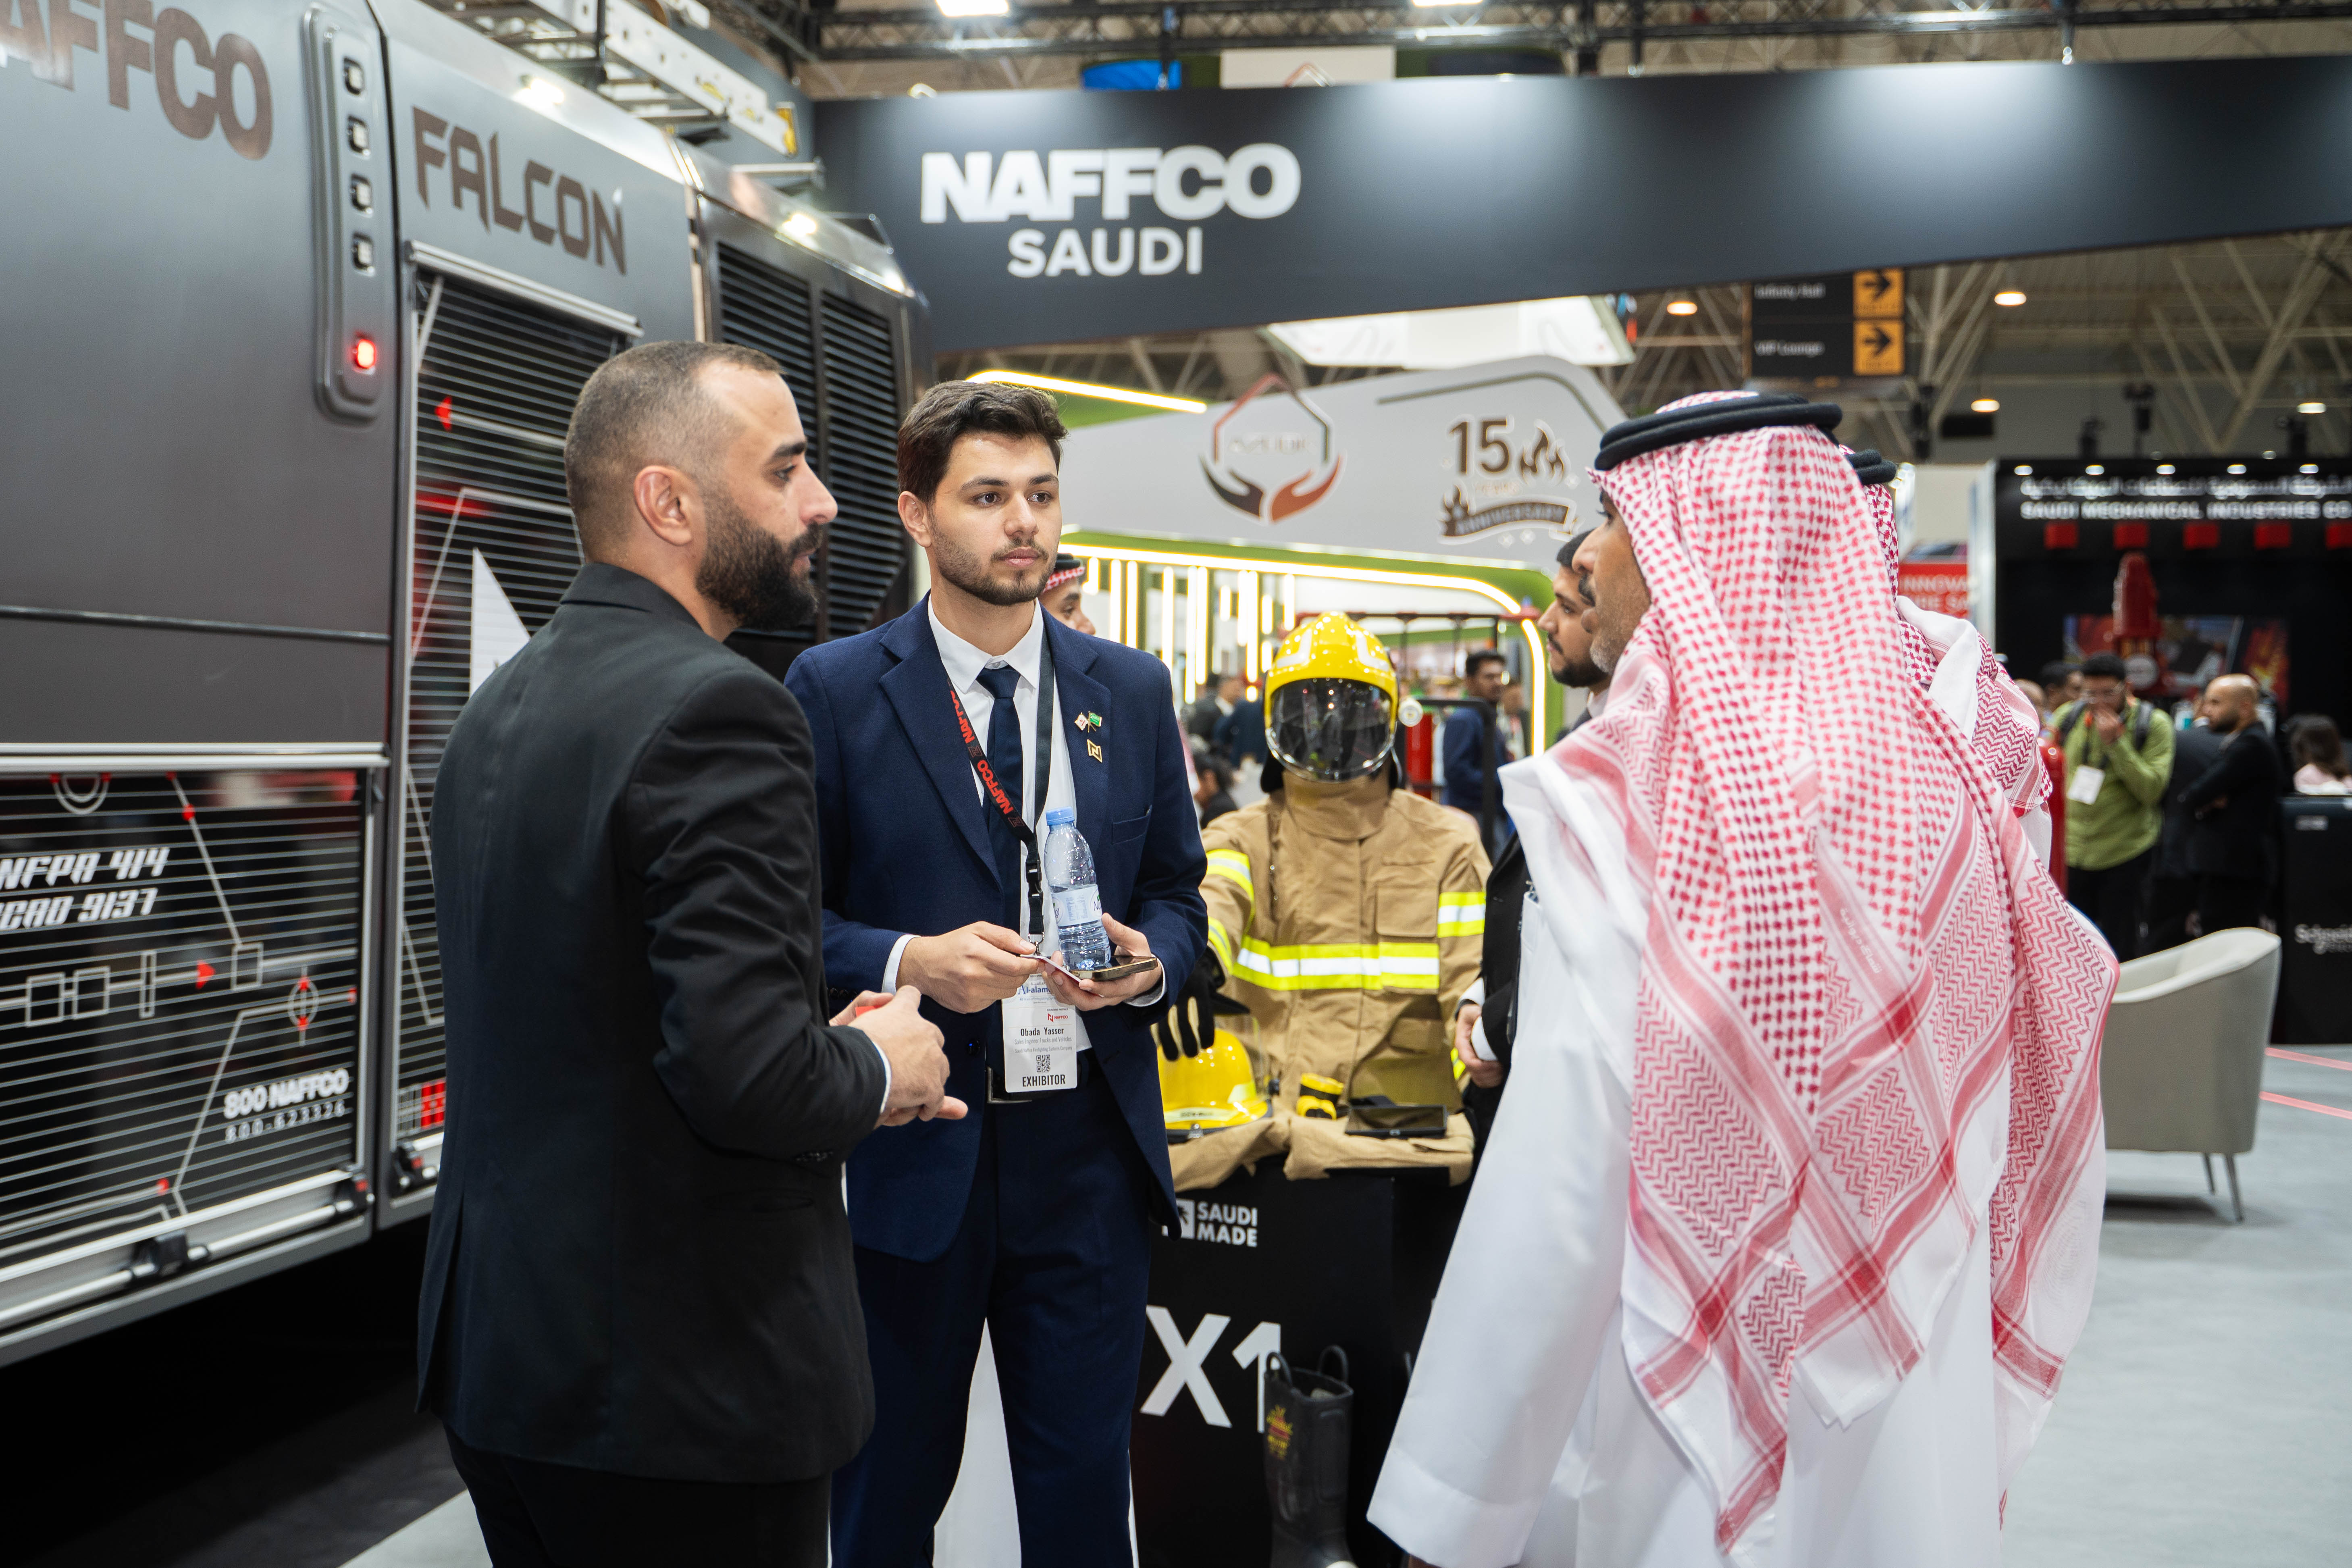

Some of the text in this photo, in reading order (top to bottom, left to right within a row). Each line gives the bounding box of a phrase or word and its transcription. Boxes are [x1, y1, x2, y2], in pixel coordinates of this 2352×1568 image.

[412, 106, 627, 276] FALCON
[920, 143, 1302, 223] NAFFCO
[1007, 227, 1203, 278] SAUDI
[1449, 421, 1510, 474] 15
[977, 759, 1014, 815] NAFFCO
[0, 847, 171, 890] NFPA 414
[77, 887, 159, 923] 9137
[1021, 1027, 1064, 1036] Obada Yasser
[223, 1068, 349, 1119] 800 NAFFCO
[1022, 1074, 1065, 1087] EXHIBITOR
[1196, 1222, 1258, 1248] MADE
[1197, 1201, 1258, 1227] SAUDI
